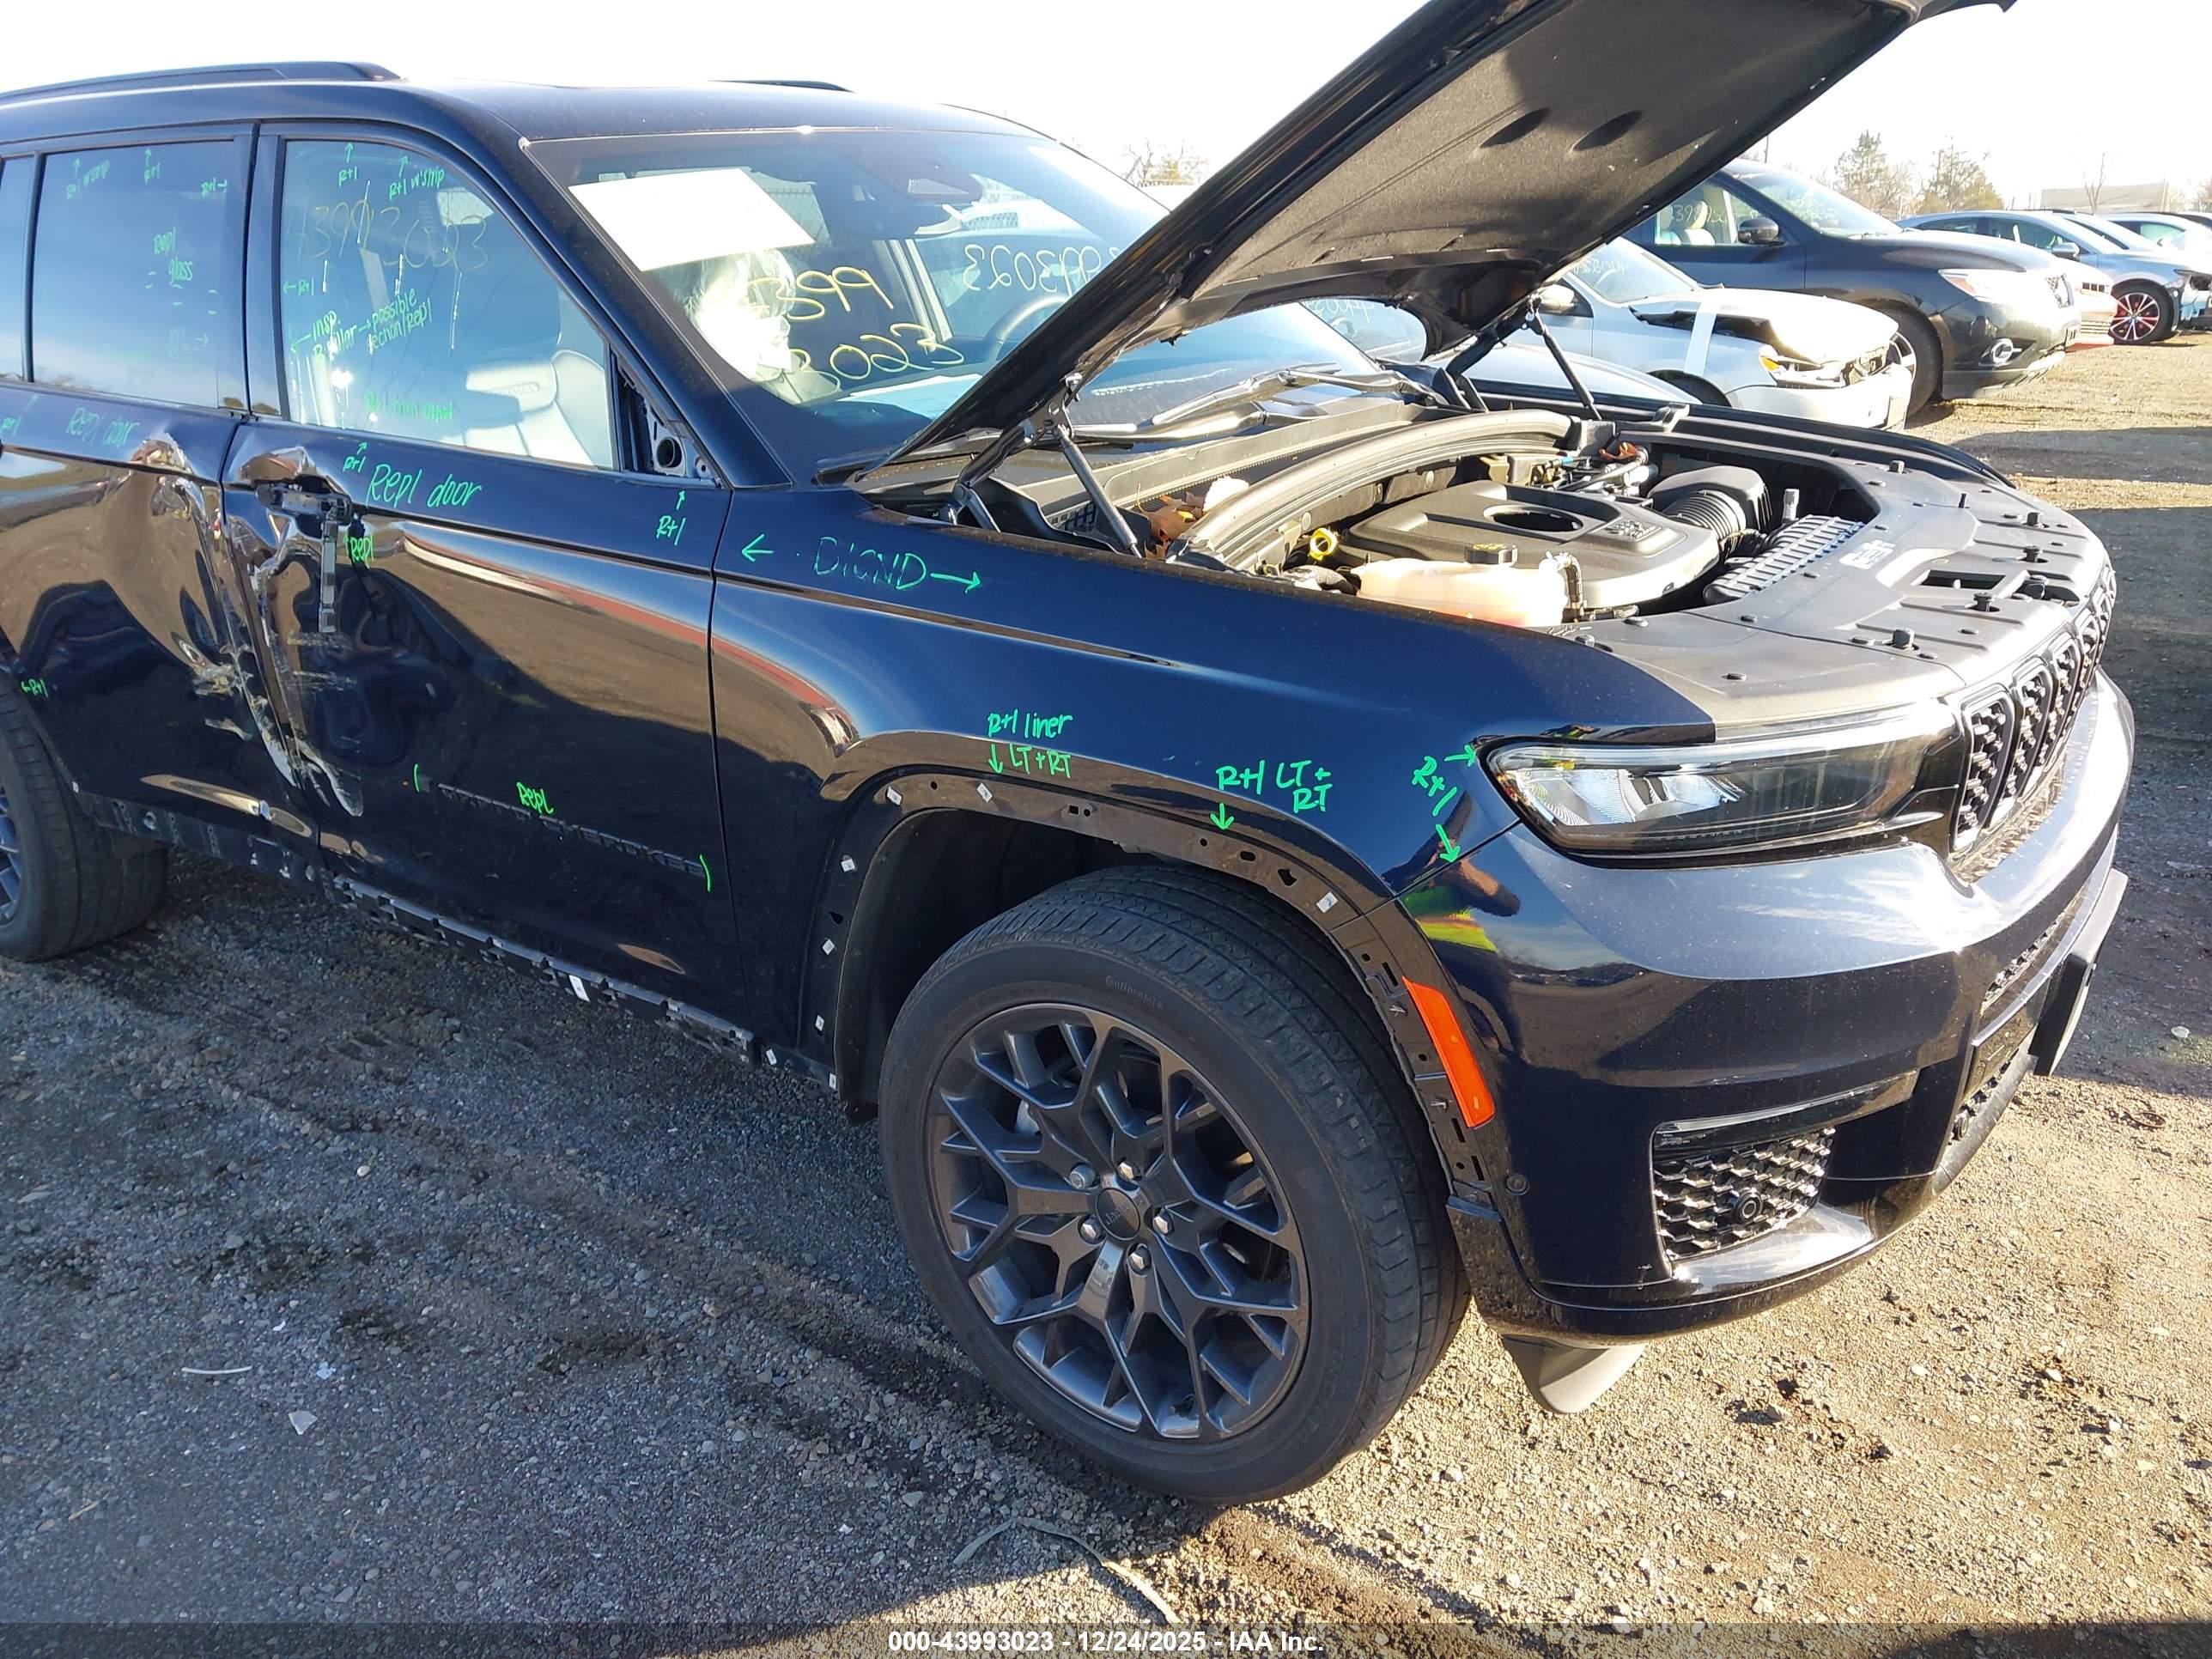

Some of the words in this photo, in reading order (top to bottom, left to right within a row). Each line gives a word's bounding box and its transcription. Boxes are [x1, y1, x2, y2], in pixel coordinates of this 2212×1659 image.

[427, 472, 483, 508] door
[1024, 713, 1073, 738] liner
[1293, 783, 1333, 813] RT
